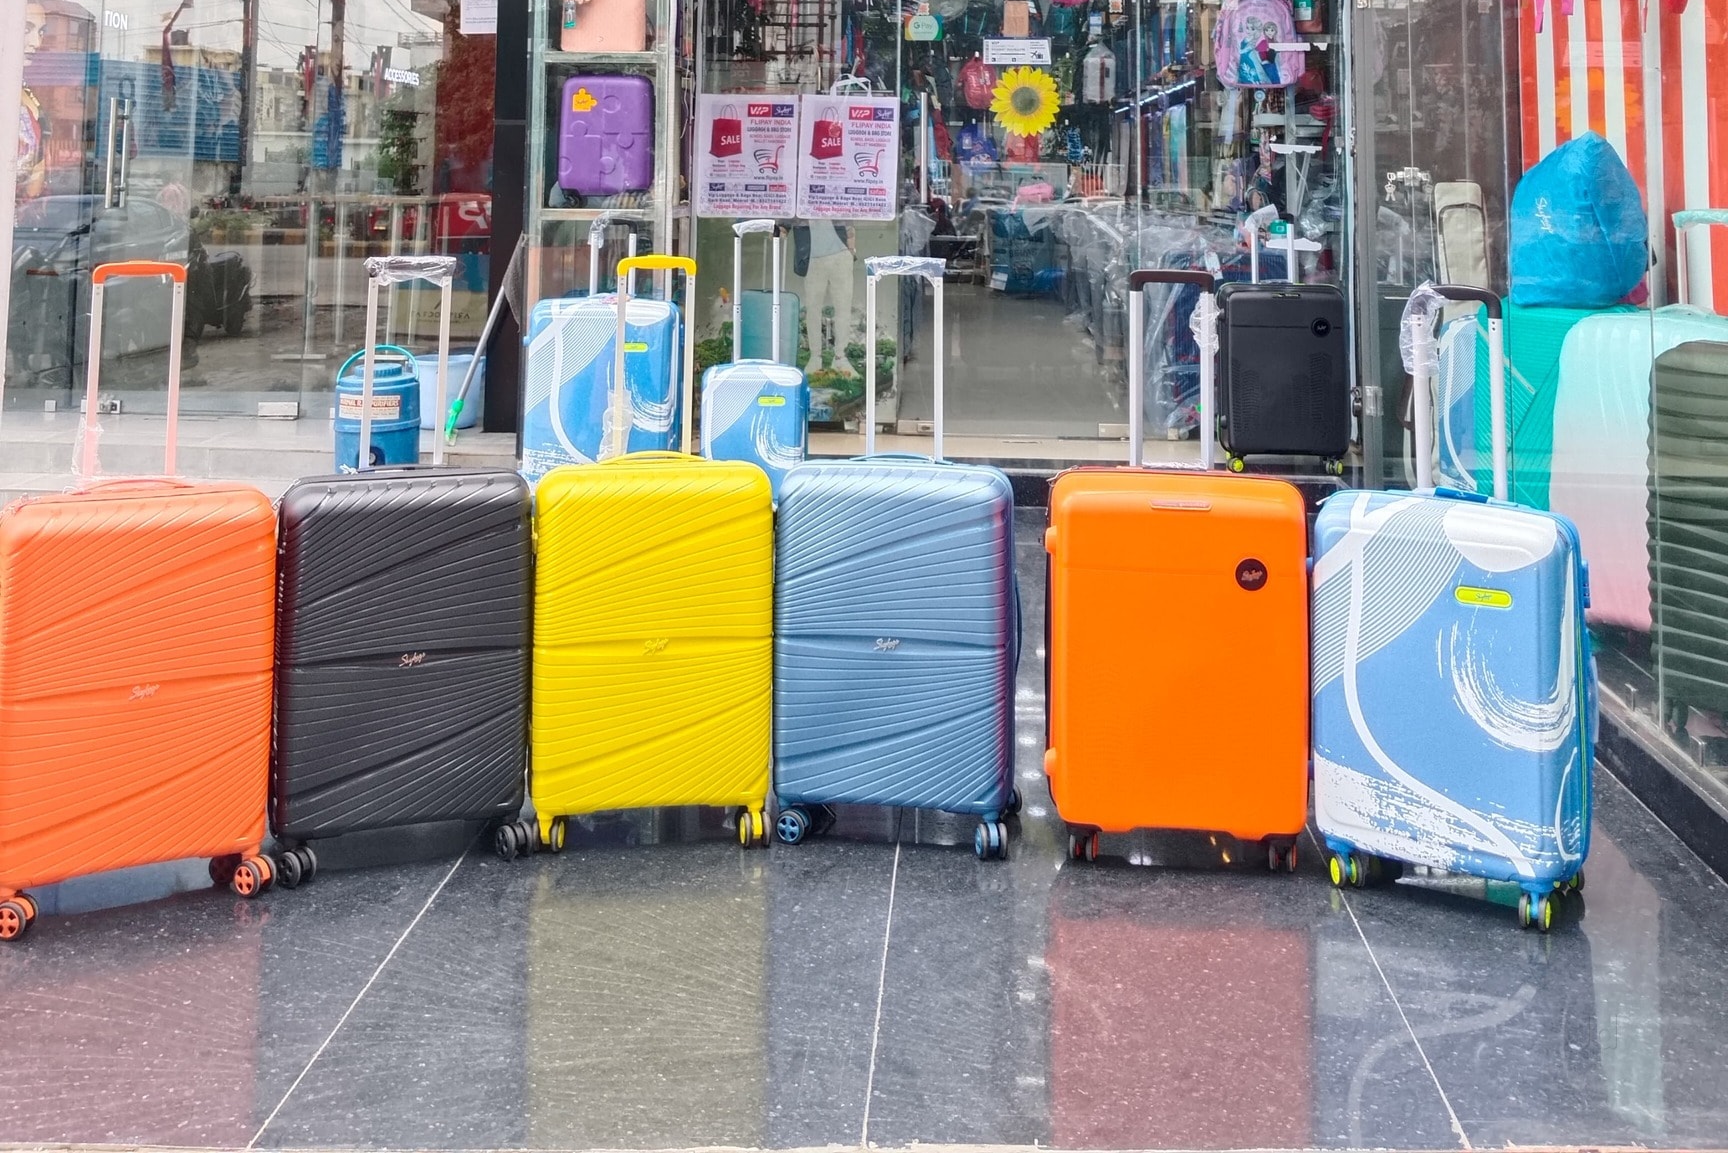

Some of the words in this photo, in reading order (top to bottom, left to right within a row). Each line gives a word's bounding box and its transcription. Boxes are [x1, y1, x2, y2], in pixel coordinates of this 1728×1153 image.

[384, 67, 420, 86] ACCESSORIES
[750, 106, 769, 115] VIP
[851, 109, 870, 118] VIP
[721, 134, 740, 146] SALE
[821, 138, 841, 148] SALE
